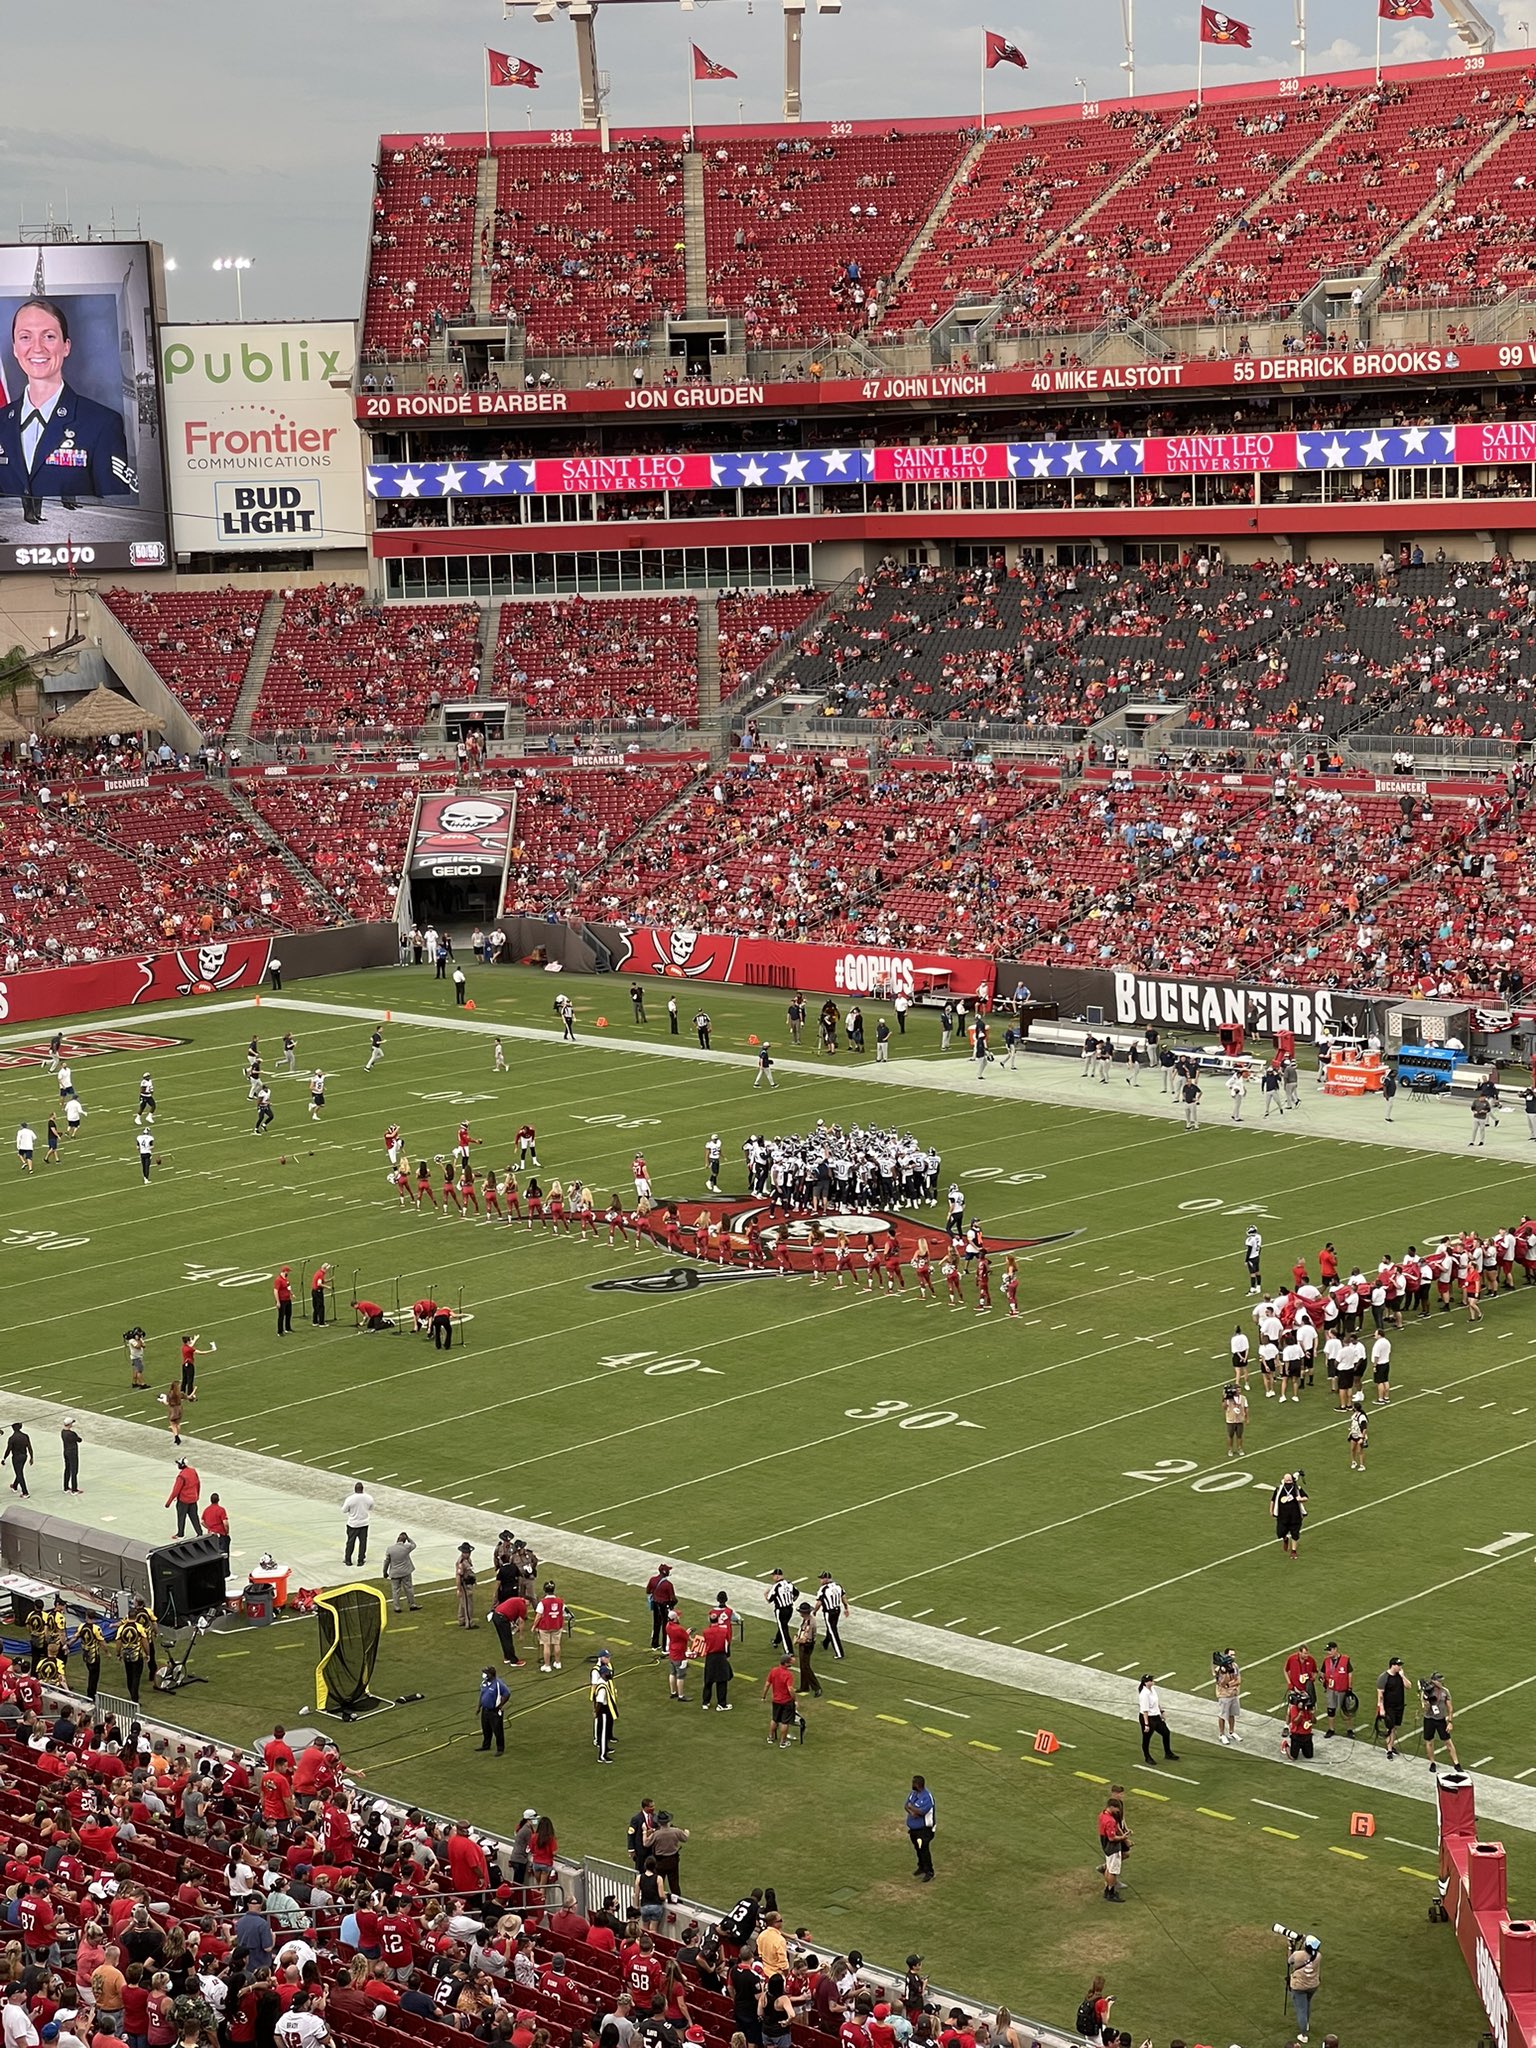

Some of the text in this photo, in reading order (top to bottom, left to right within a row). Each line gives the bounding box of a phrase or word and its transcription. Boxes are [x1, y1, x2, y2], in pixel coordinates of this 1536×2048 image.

[1464, 57, 1485, 71] 339
[1279, 79, 1299, 93] 340
[1082, 103, 1099, 117] 341
[551, 132, 573, 143] 343
[831, 123, 853, 135] 342
[423, 136, 445, 146] 344
[164, 340, 340, 384] Publix
[1498, 346, 1523, 367] 99
[1233, 351, 1441, 382] 55 DERRICK BROOKS
[862, 376, 986, 398] 47 JOHN LYNCH
[1031, 365, 1183, 390] 40 MIKE ALSTOTT
[367, 399, 389, 416] 20
[478, 394, 567, 413] BARBER
[625, 387, 764, 409] JON GRUDEN
[184, 421, 337, 455] Frontier
[1166, 435, 1273, 458] SAINT LEO
[187, 454, 331, 470] COMMUNICATIONS
[893, 445, 987, 467] SAINT LEO
[562, 456, 685, 479] SAINT LEO
[234, 487, 301, 509] BUD
[223, 510, 315, 534] LIGHT
[15, 546, 96, 565] $12,070
[1375, 780, 1427, 794] BUCCANEERS
[419, 856, 495, 867] GEICO
[432, 865, 481, 877] GEICO
[1334, 1074, 1367, 1084] GATORADE
[959, 1167, 1047, 1186] 50
[1, 1230, 91, 1251] 30
[181, 1267, 273, 1287] 40
[596, 1351, 701, 1376] 40
[844, 1400, 960, 1430] 30
[1122, 1459, 1254, 1492] 20
[1038, 1733, 1051, 1751] 10
[1355, 1816, 1370, 1834] G
[21, 1912, 35, 1931] 87
[383, 1934, 404, 1953] 12
[631, 1972, 649, 1991] 98
